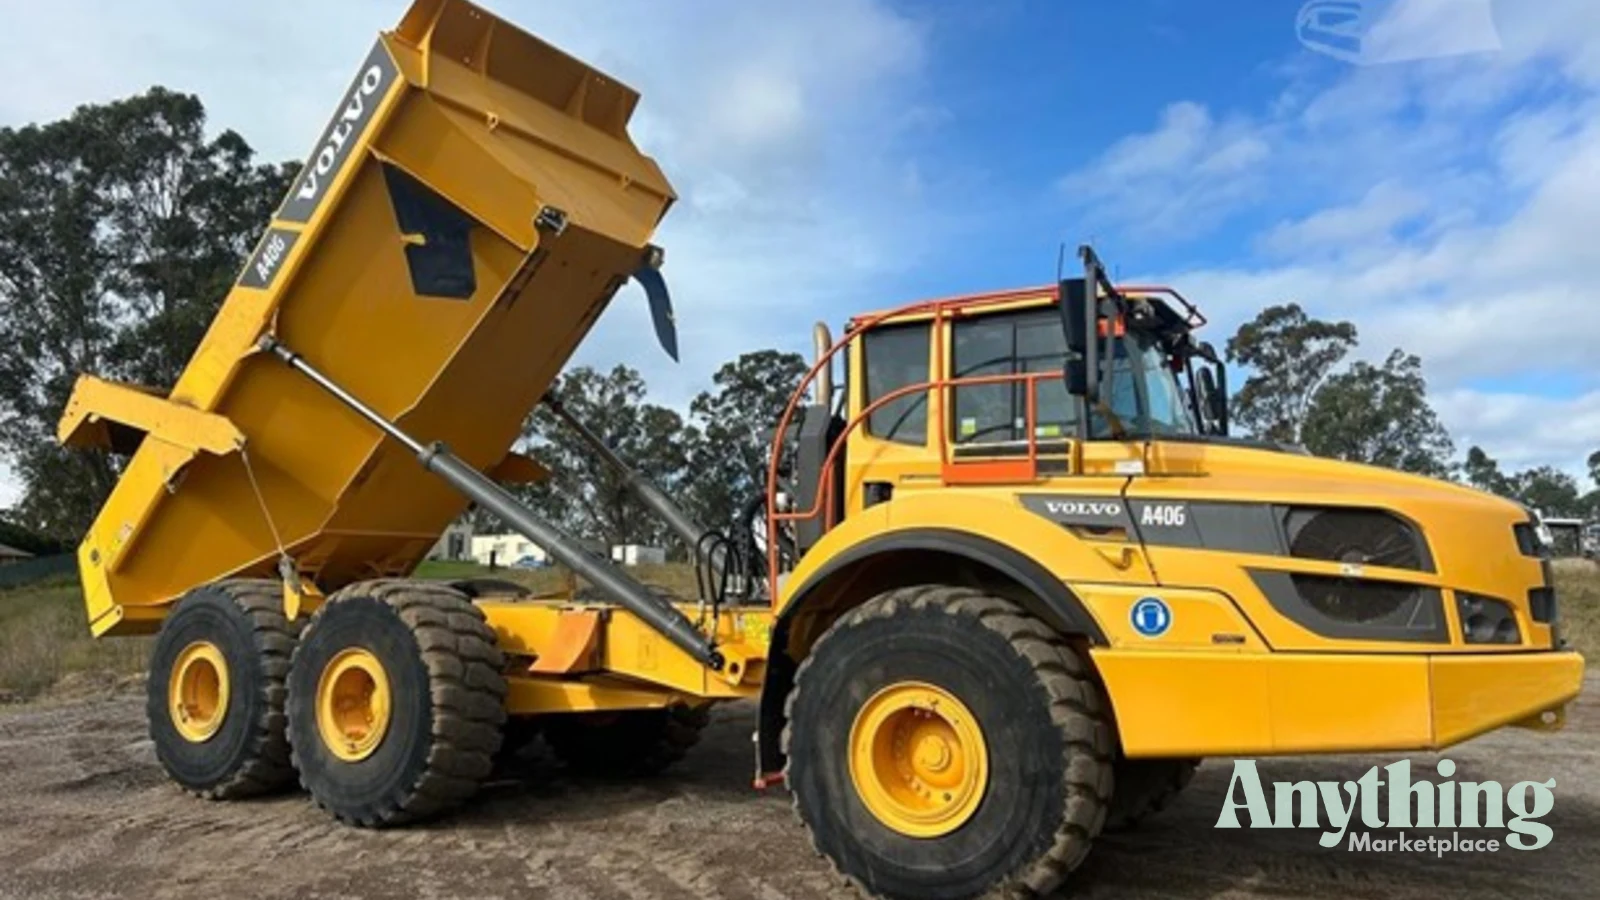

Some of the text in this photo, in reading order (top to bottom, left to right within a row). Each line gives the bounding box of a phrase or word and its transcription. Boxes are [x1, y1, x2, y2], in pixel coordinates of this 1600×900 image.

[297, 65, 382, 200] VOLVO
[255, 234, 286, 282] A40G
[1046, 501, 1186, 526] VOLVO A40G
